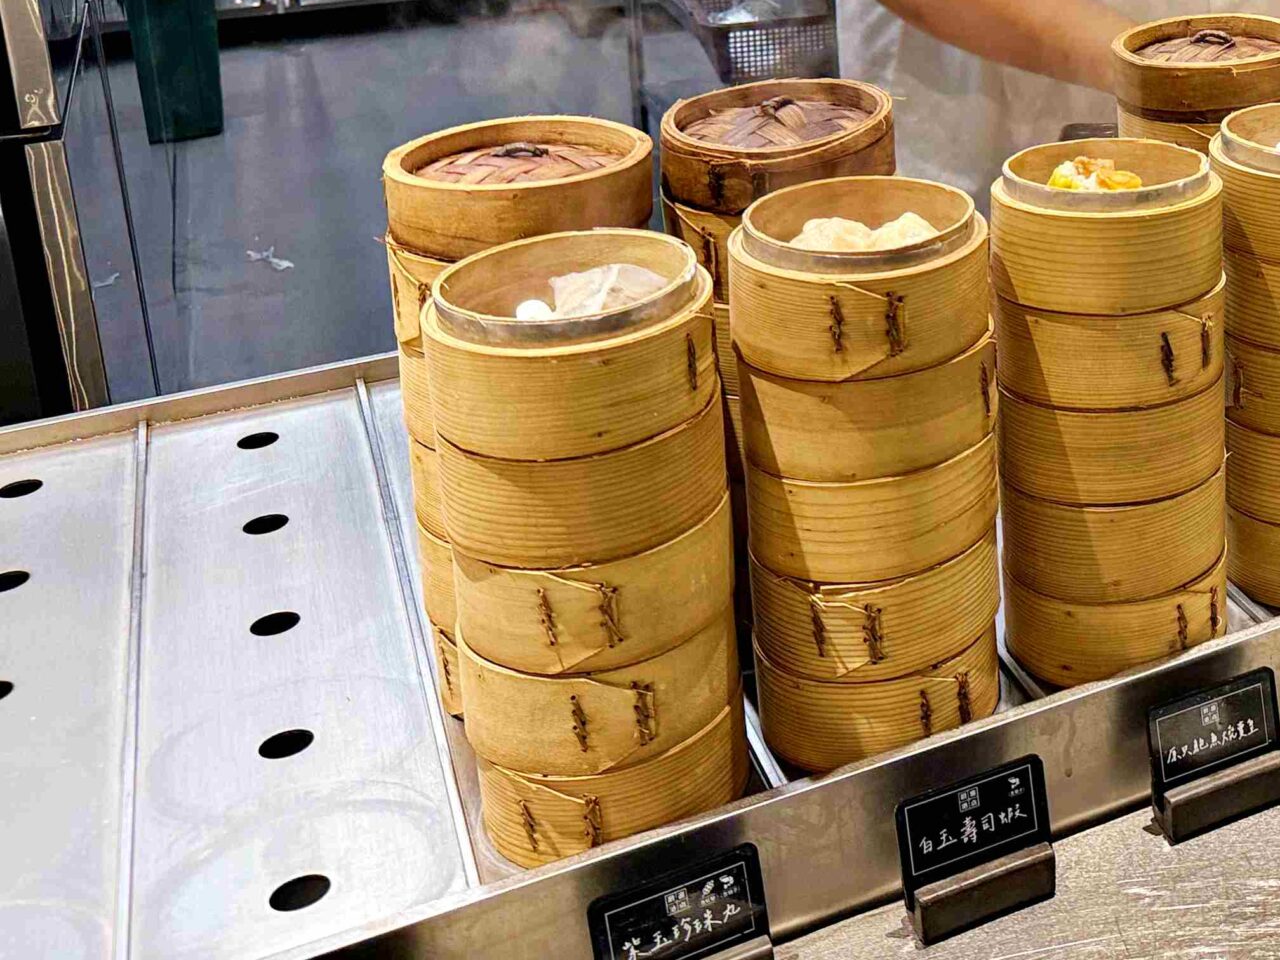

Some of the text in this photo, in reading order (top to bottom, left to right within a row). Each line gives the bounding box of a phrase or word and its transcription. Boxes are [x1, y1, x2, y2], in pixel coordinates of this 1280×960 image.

[919, 803, 1028, 855] 白玉壽司蝦
